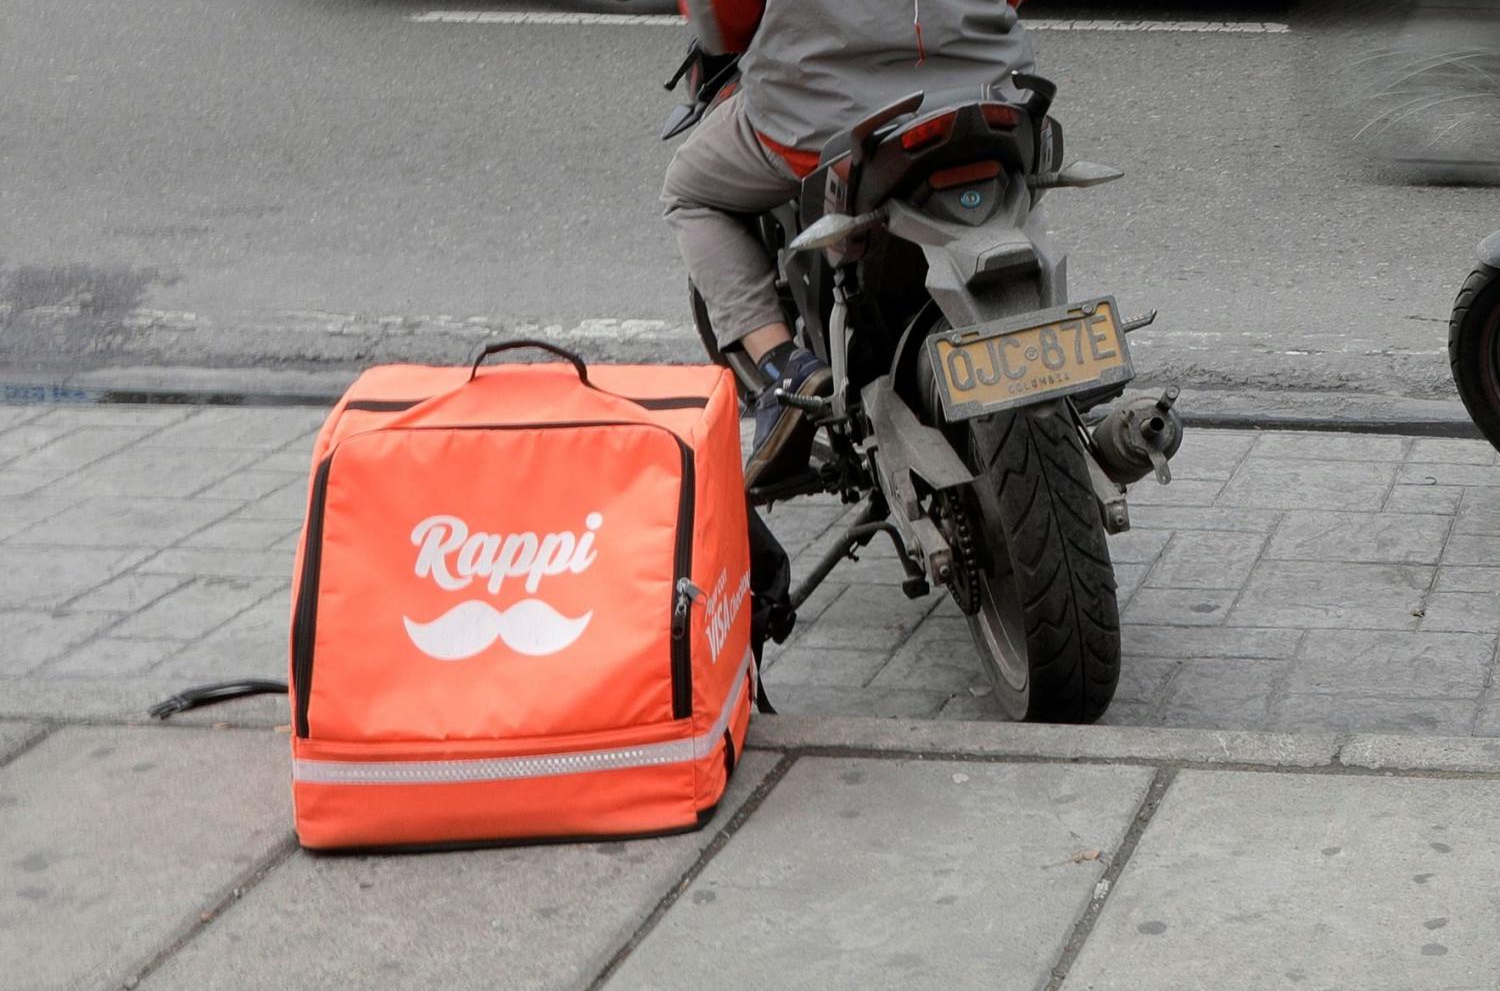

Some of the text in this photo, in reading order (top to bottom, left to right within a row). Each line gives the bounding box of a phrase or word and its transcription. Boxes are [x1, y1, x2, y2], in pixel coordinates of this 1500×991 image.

[947, 314, 1116, 392] QJC 87E
[1007, 372, 1071, 394] COLOMBIA
[410, 511, 603, 595] Rappi
[705, 592, 731, 666] VISA
